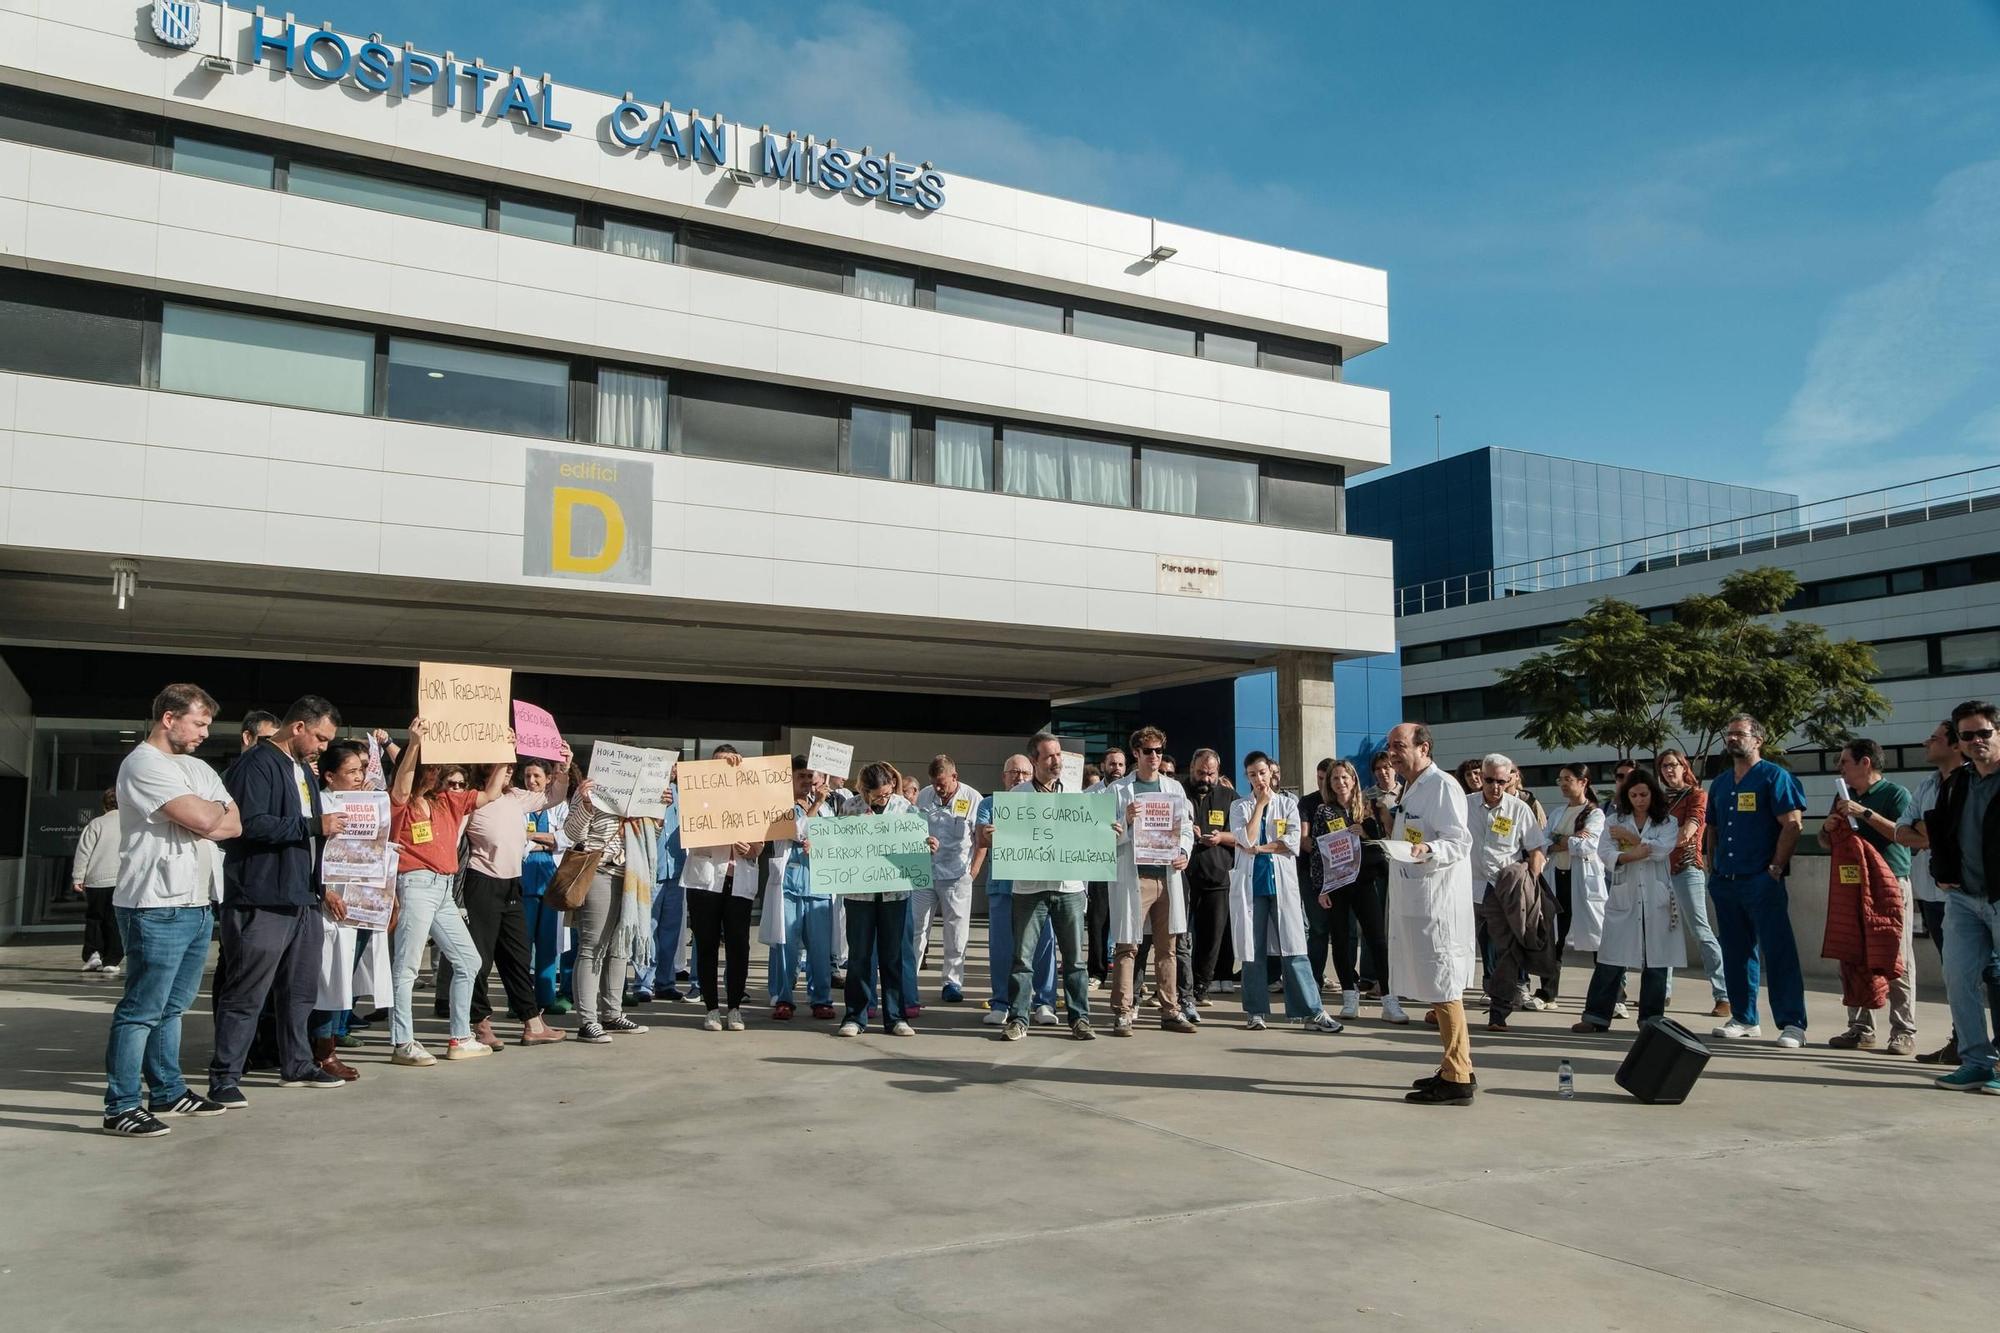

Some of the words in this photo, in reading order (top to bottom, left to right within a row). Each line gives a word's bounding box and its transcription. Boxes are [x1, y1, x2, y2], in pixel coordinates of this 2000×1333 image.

[253, 15, 572, 133] HOSPITAL
[611, 101, 726, 166] CAN
[763, 134, 946, 211] MISSES
[559, 462, 617, 482] edifici
[551, 486, 626, 574] D
[420, 678, 448, 701] HORA
[449, 677, 503, 704] TRABAJADA
[423, 720, 451, 743] HORA
[453, 722, 504, 743] COTIZADA
[596, 748, 615, 758] HORA
[683, 772, 732, 791] ILEGAL
[735, 769, 760, 787] PARA
[761, 767, 793, 784] TODOS
[345, 804, 375, 813] HUELGA
[346, 813, 376, 822] MÉDICA
[993, 806, 1011, 820] NO
[1017, 806, 1037, 821] ES
[681, 813, 718, 833] LEGAL
[721, 809, 744, 830] PARA
[747, 809, 761, 826] EL
[810, 823, 829, 837] SIN
[874, 821, 890, 834] SIN
[1032, 827, 1054, 841] ES
[1328, 837, 1349, 849] HUELGA
[809, 848, 823, 860] UN
[827, 846, 862, 860] ERROR
[866, 843, 897, 859] PUEDE
[901, 840, 931, 855] MATAR
[992, 844, 1056, 863] EXPLOTACIÓN
[1060, 848, 1117, 864] LEGALIZADA
[1330, 844, 1350, 855] MÉDICA
[816, 866, 860, 886] STOP
[862, 865, 922, 883] GUARDIAS
